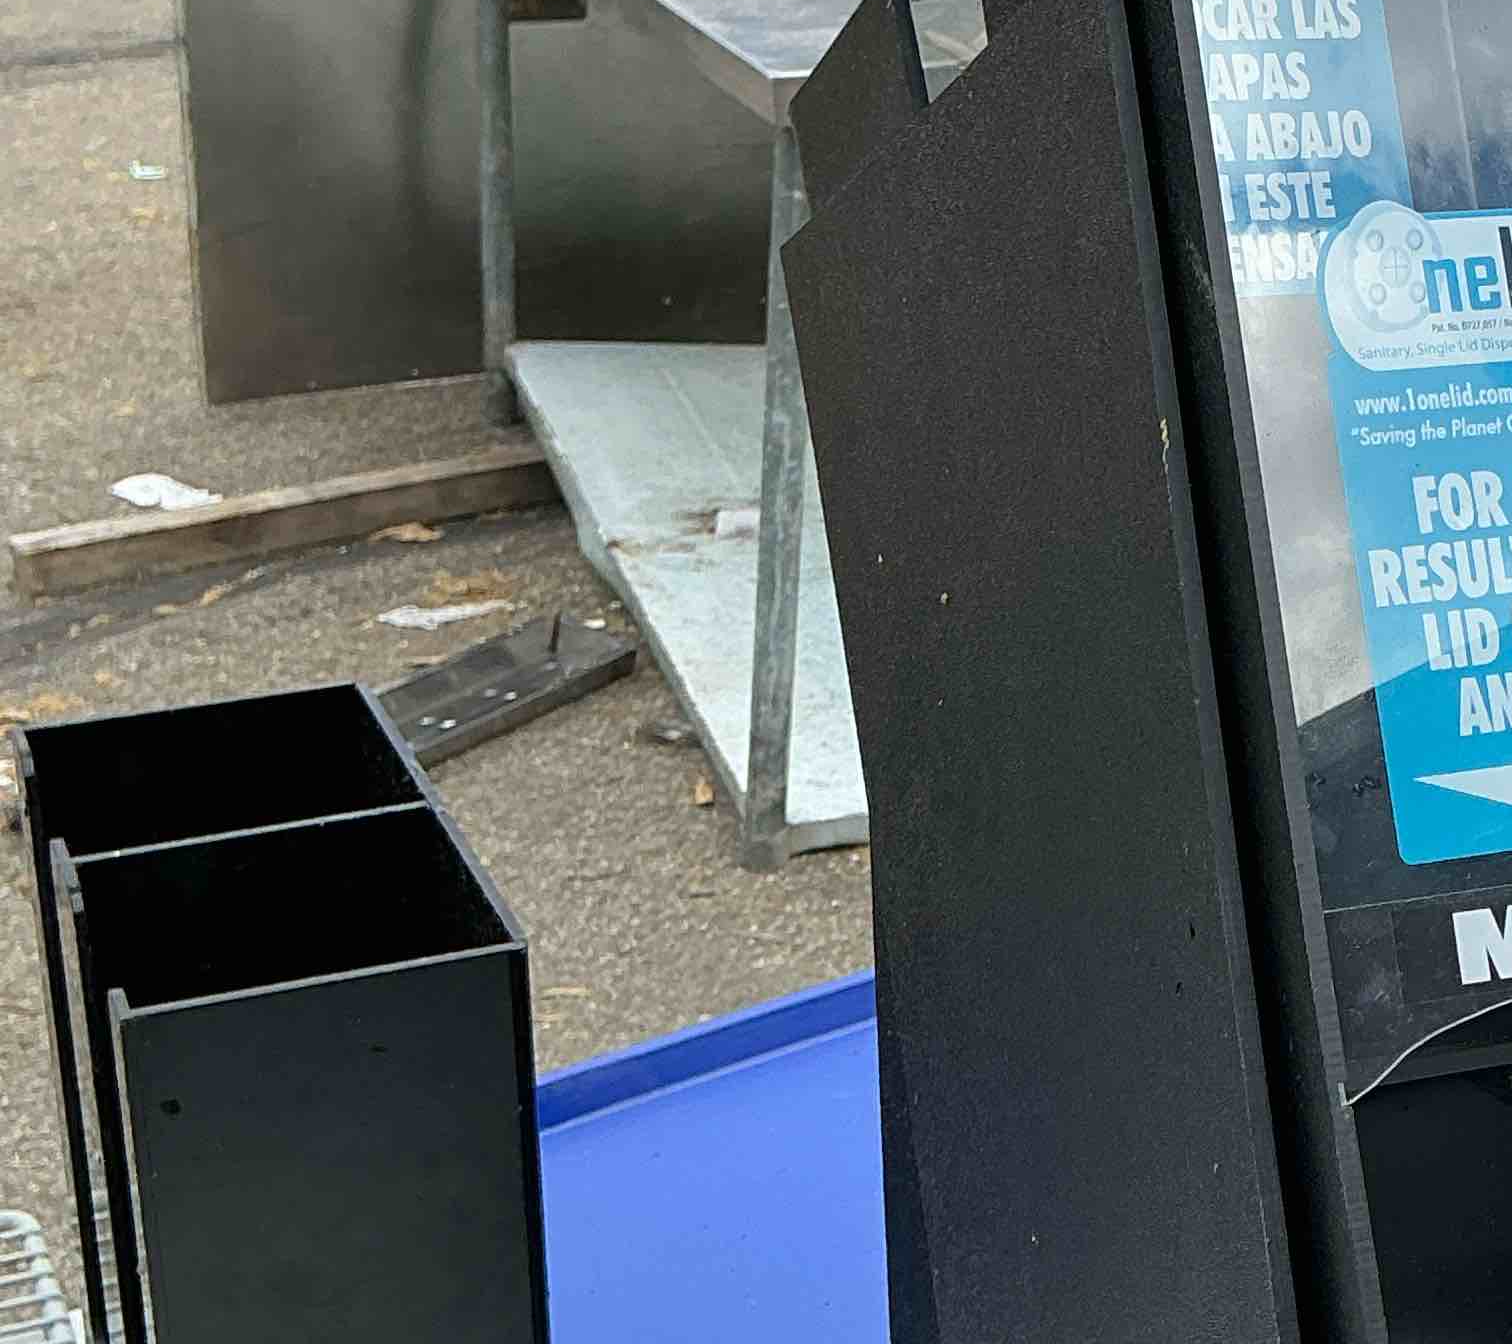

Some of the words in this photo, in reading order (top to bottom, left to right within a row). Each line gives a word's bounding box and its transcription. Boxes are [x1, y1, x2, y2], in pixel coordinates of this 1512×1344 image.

[1247, 109, 1372, 161] ABAJO
[1244, 170, 1337, 222] ESTE
[1420, 420, 1448, 441] the
[1451, 414, 1503, 439] Planet
[1411, 469, 1508, 537] FOR
[1421, 606, 1500, 673] LID
